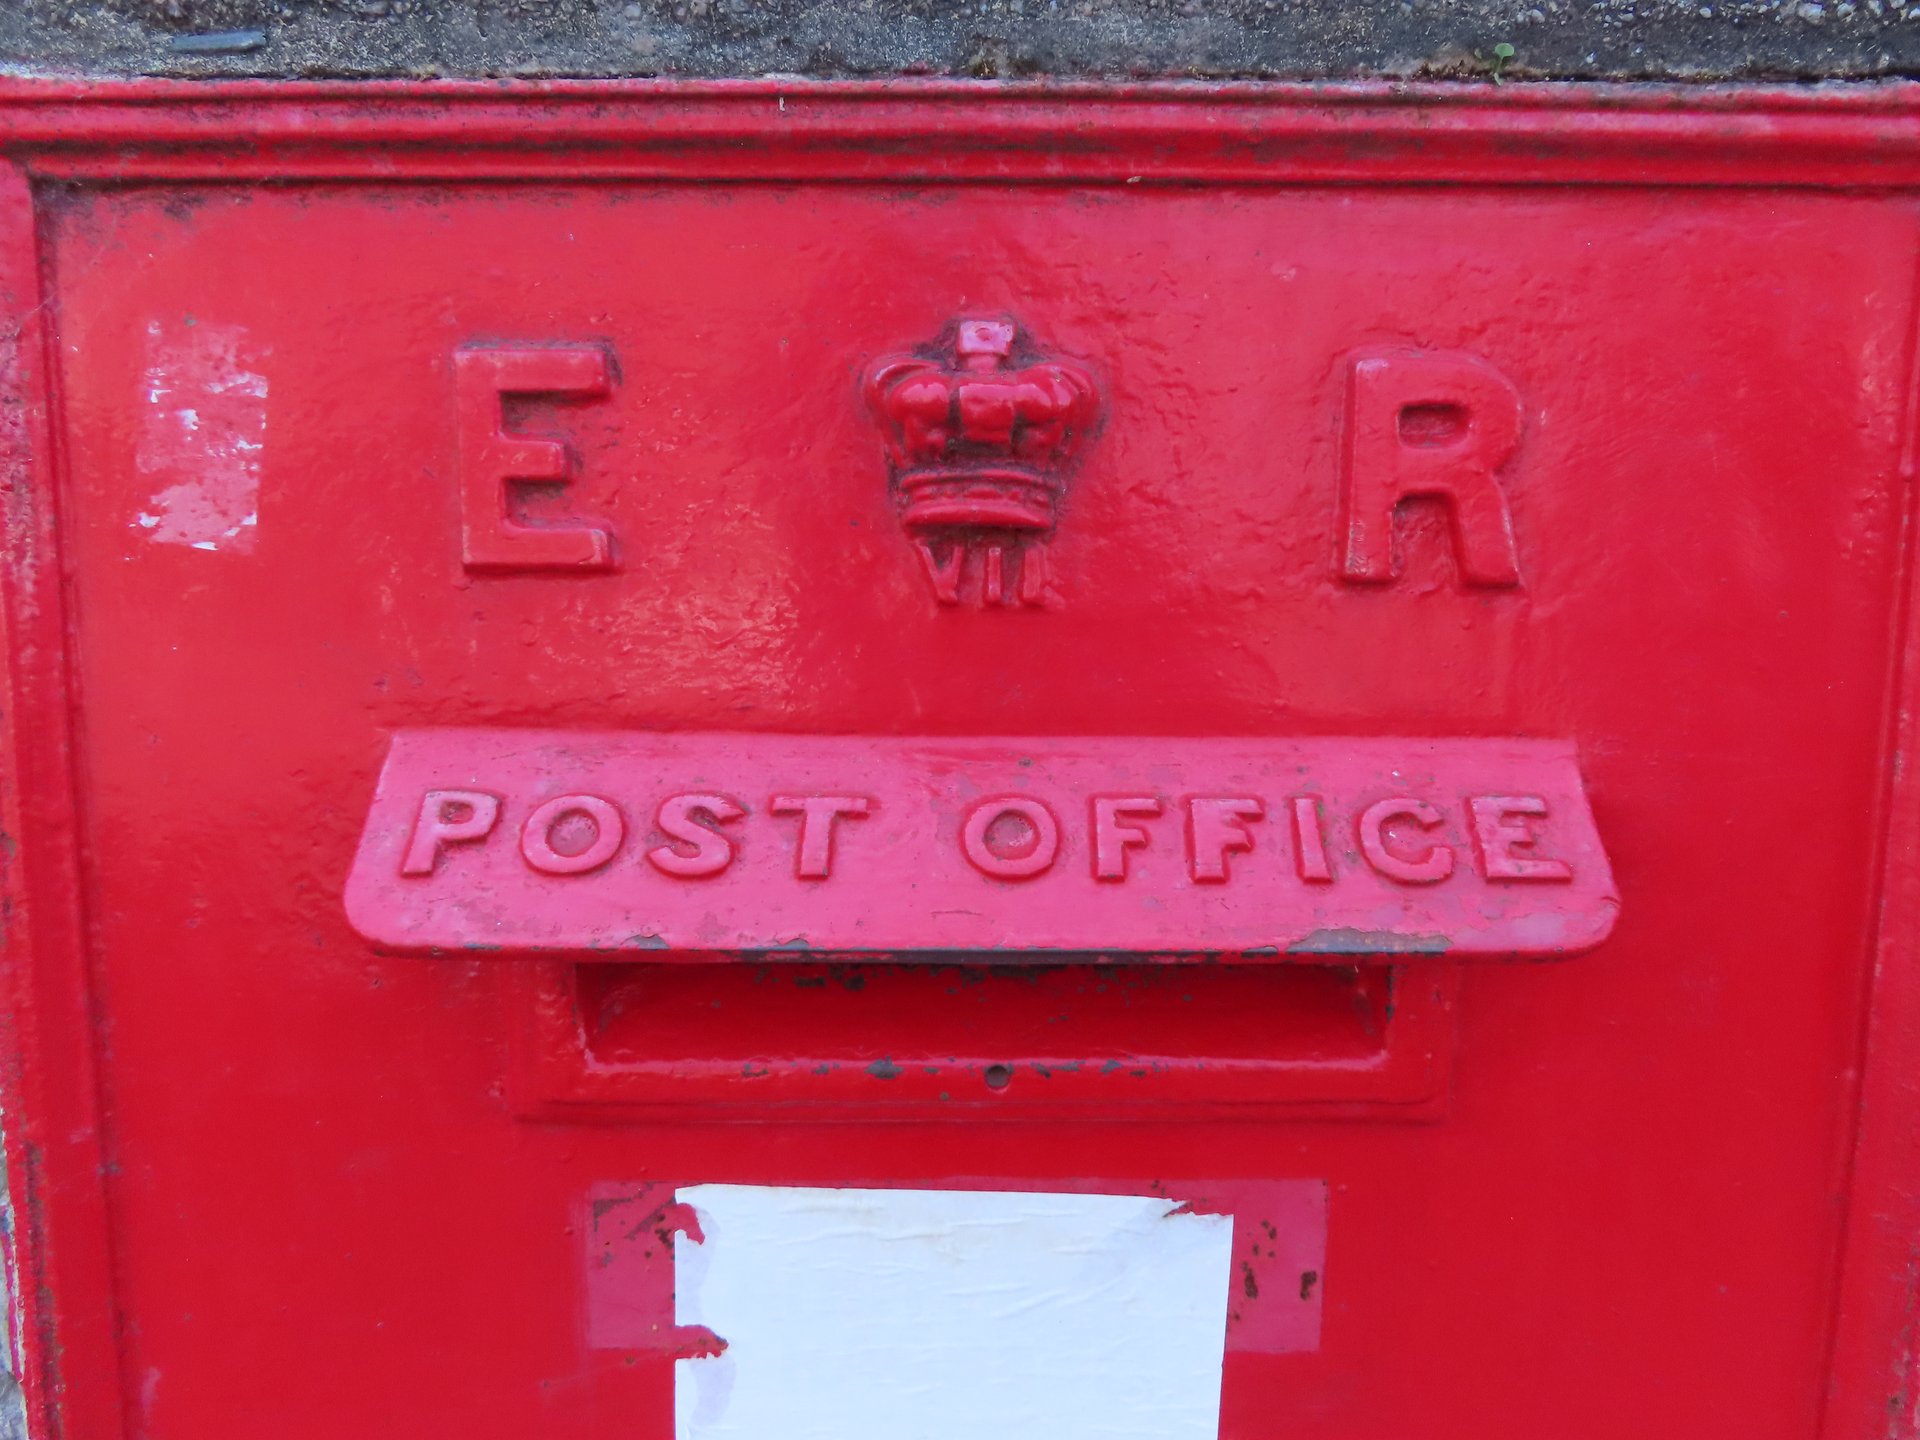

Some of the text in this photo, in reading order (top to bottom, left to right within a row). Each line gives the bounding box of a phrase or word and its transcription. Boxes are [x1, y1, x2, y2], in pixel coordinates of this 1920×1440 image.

[453, 345, 1525, 590] E R
[914, 540, 1050, 604] VII
[400, 789, 1573, 884] POST OFFICE
